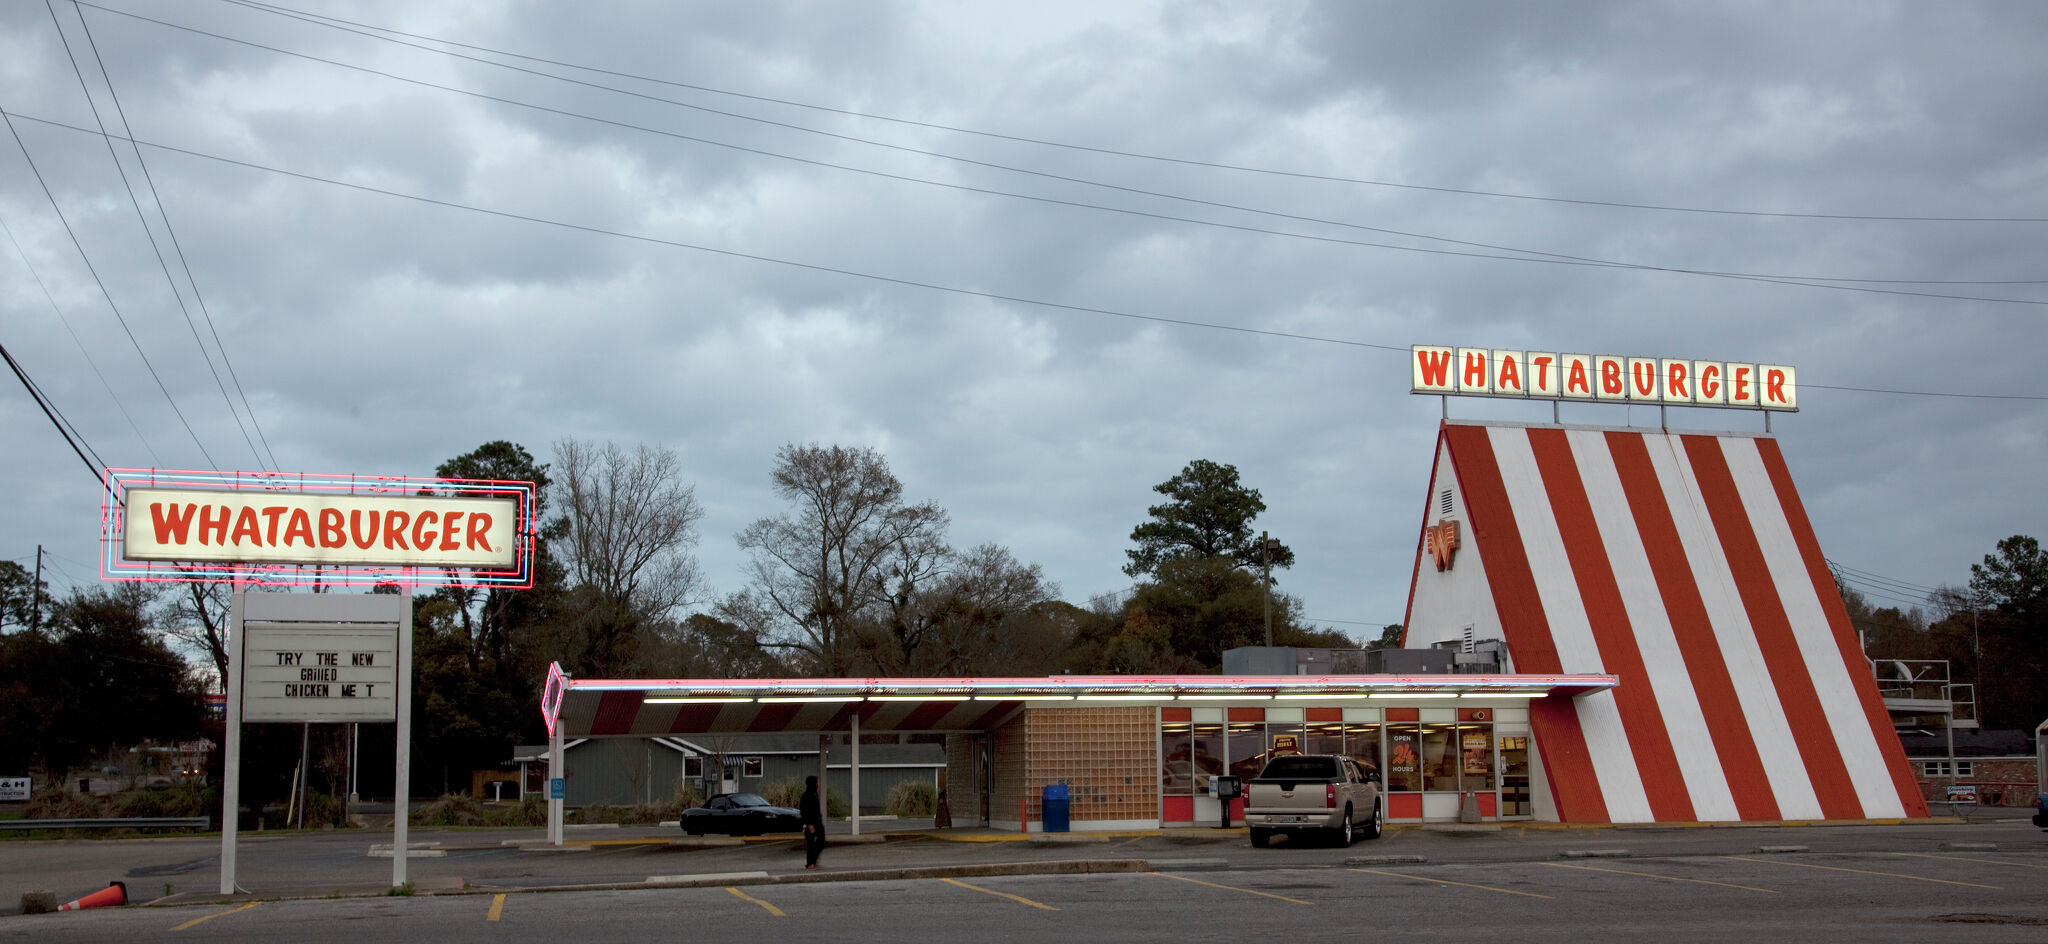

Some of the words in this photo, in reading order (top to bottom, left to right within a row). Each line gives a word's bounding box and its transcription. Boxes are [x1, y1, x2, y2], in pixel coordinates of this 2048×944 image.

[1417, 350, 1786, 403] WHATABURGER
[149, 503, 493, 552] WHATABURGER
[276, 652, 303, 665] TRY
[316, 652, 338, 666] THE
[352, 653, 374, 666] NEW
[285, 683, 329, 697] CHICKEN
[1392, 743, 1414, 764] 24
